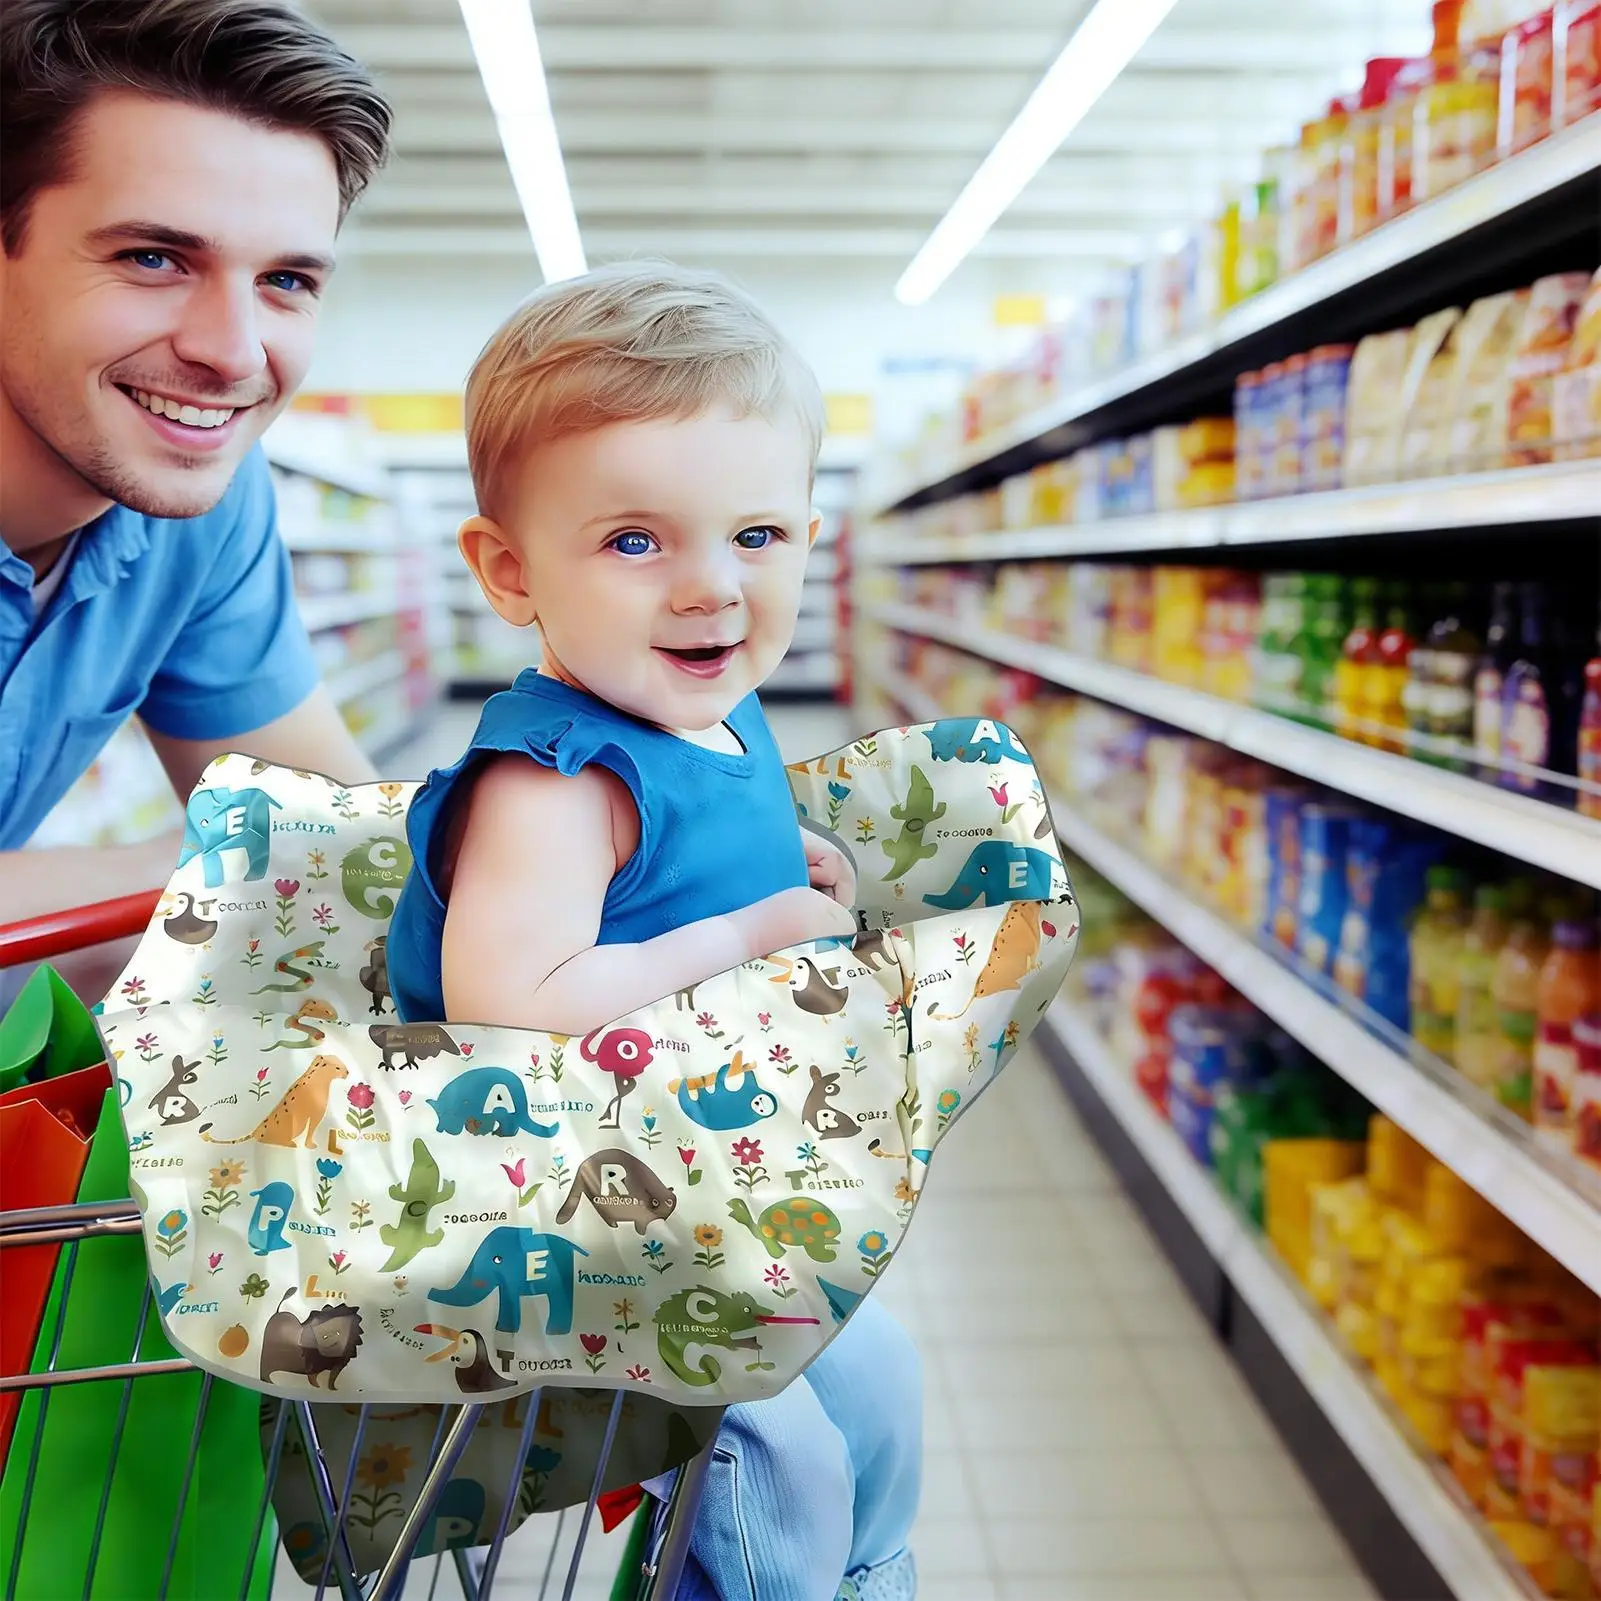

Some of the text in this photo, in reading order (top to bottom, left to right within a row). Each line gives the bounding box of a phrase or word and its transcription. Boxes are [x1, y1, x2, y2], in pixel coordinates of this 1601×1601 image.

[226, 806, 247, 836] E
[368, 842, 398, 868] C
[1008, 861, 1028, 888] E
[617, 1040, 639, 1060] O
[162, 1096, 187, 1118] R
[483, 1083, 516, 1114] A
[600, 1163, 629, 1197] R
[258, 1205, 284, 1231] P
[526, 1249, 549, 1281] E
[686, 1291, 720, 1323] C
